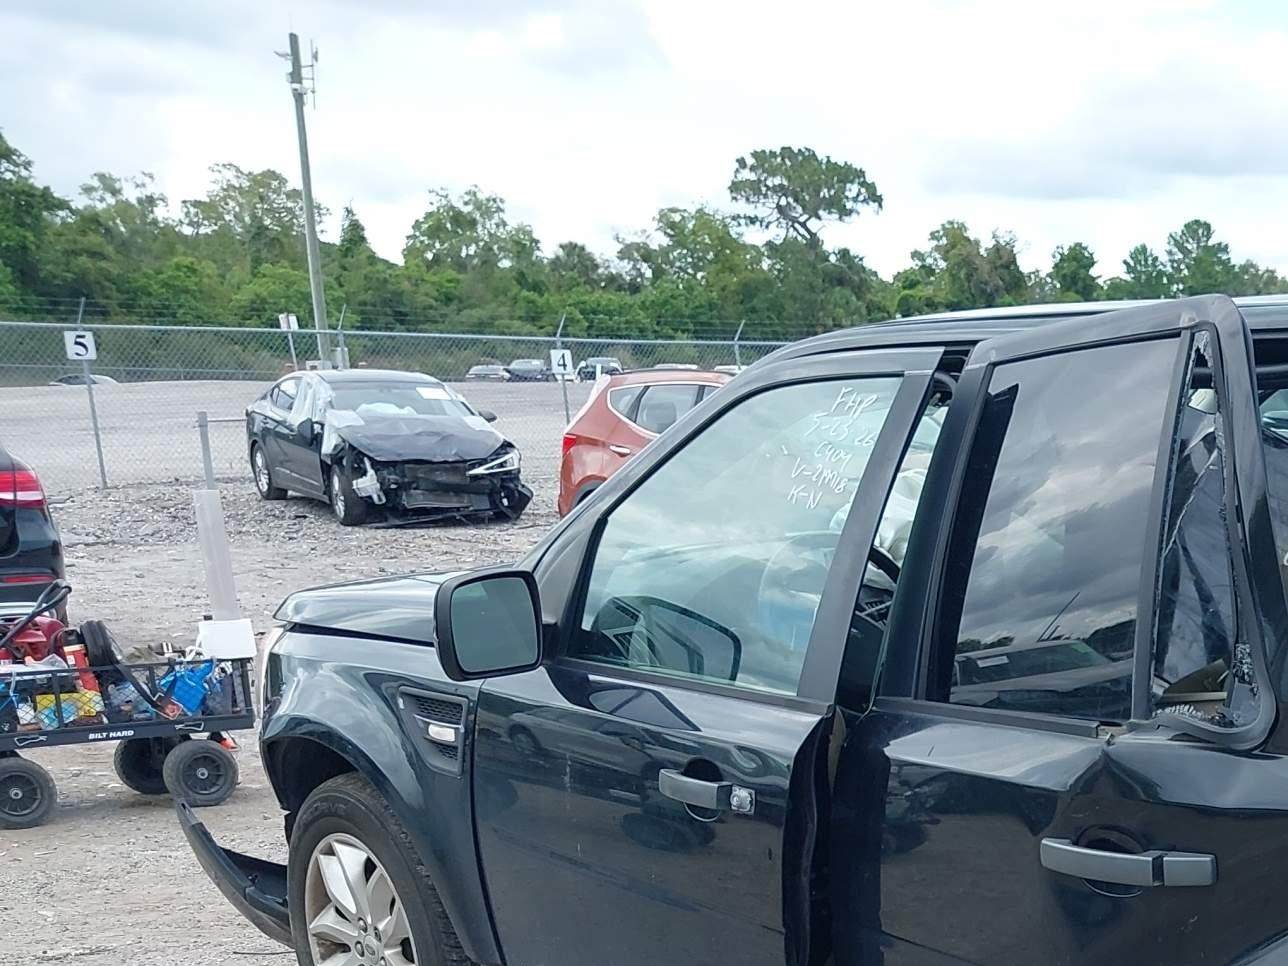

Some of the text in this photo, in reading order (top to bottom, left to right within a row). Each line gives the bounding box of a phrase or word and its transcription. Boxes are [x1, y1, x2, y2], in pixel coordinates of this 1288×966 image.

[74, 334, 89, 357] 5
[557, 352, 568, 372] 4
[109, 730, 135, 739] HARD
